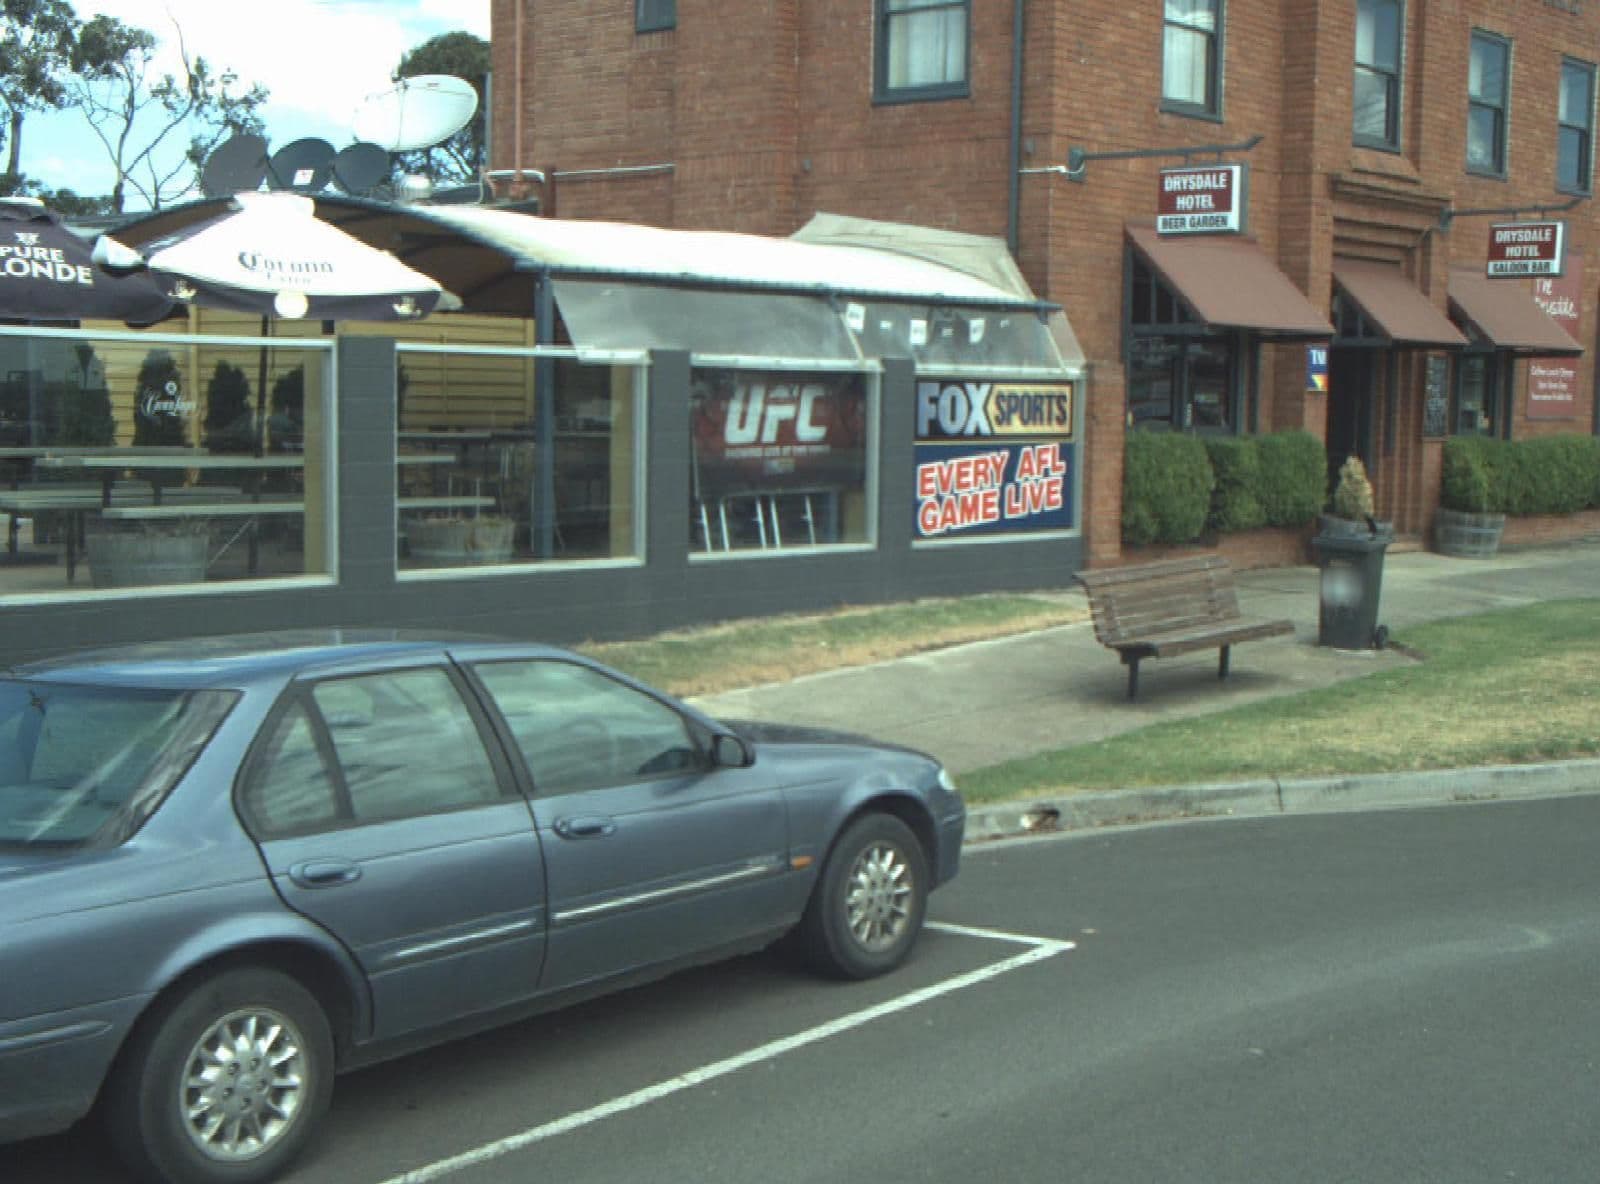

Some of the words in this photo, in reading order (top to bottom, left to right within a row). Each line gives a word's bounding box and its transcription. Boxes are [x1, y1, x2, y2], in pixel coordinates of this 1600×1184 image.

[1164, 172, 1227, 191] DRYSDALE
[1176, 194, 1215, 211] HOTEL
[1496, 229, 1552, 243] DRYSDALE
[0, 246, 64, 263] PURE
[1505, 246, 1541, 258] HOTEL
[724, 384, 827, 444] UFC
[917, 382, 993, 436] FOX
[995, 393, 1067, 426] SPORTS
[917, 451, 1009, 499] EVERY
[1015, 443, 1066, 481] AFL
[918, 487, 1000, 535] GAME
[1005, 477, 1063, 519] LIVE
